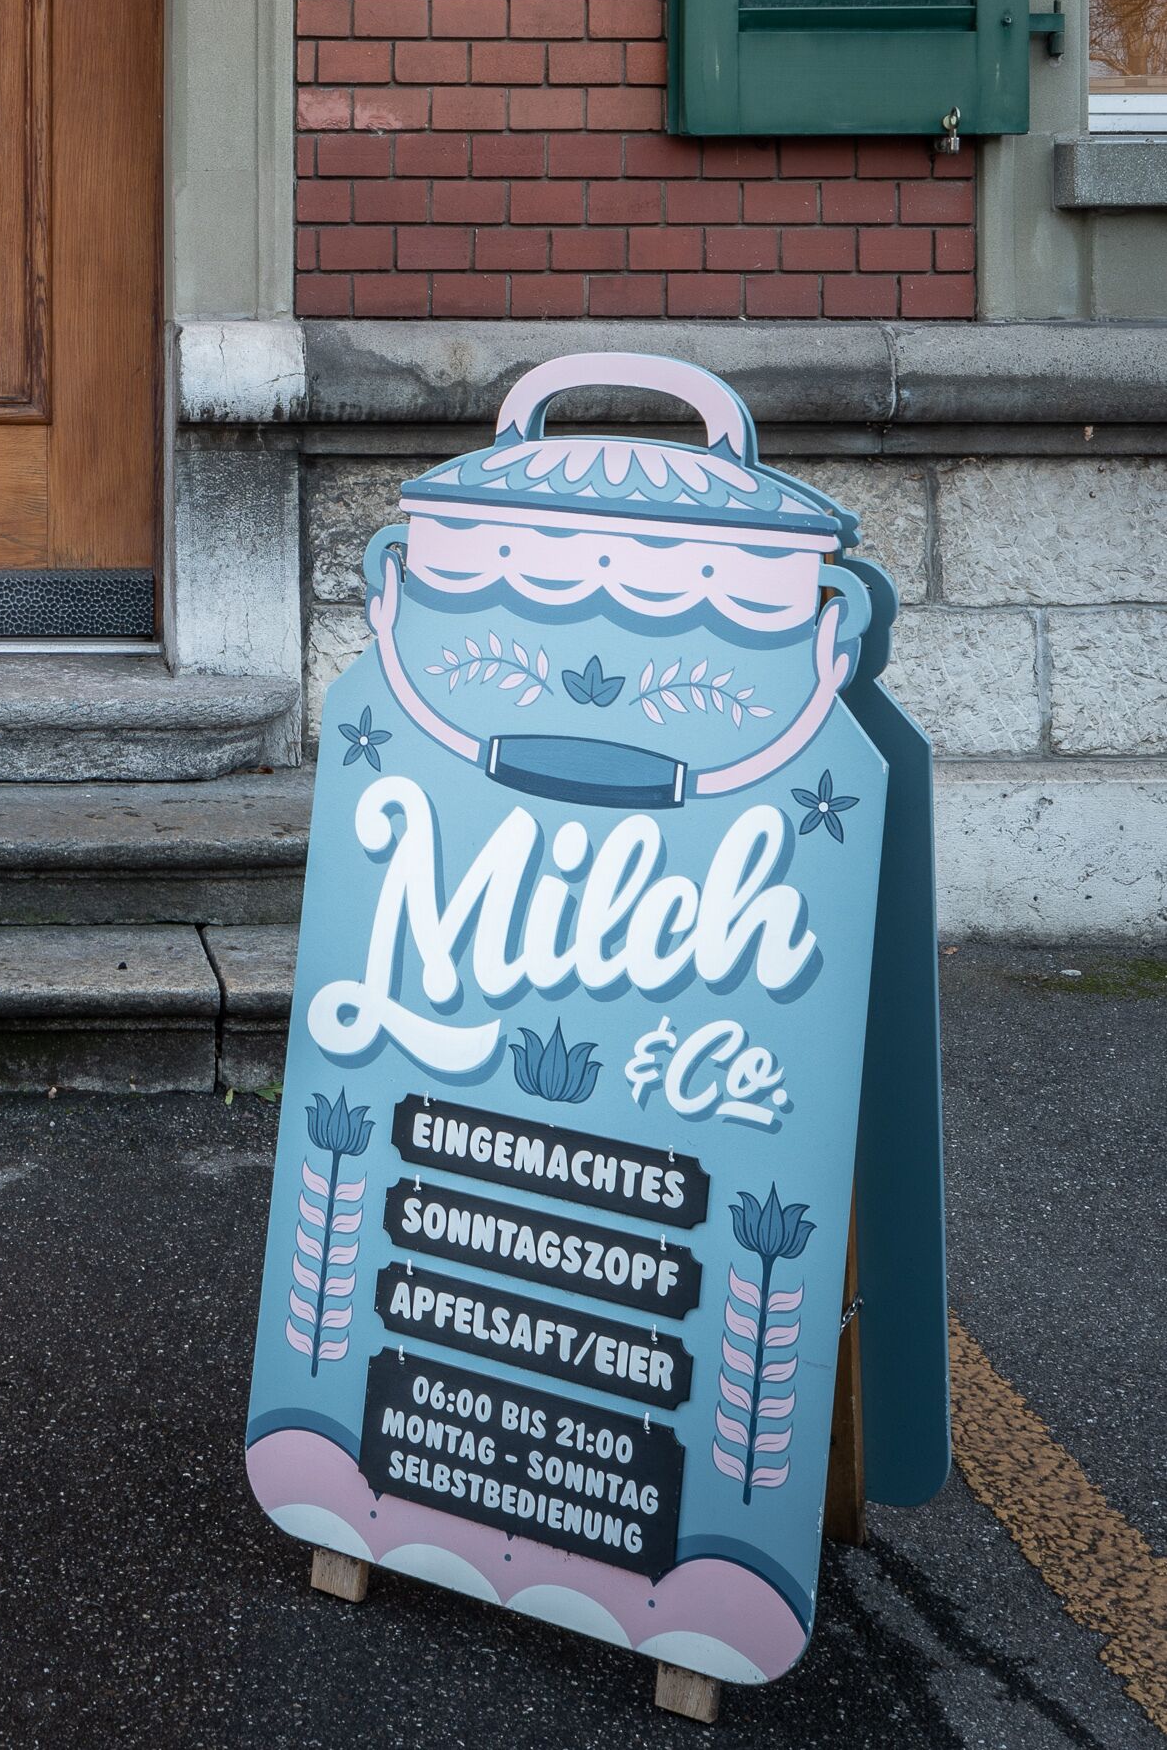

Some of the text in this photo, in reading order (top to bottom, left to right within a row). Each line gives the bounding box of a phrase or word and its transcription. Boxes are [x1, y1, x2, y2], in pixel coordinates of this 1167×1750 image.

[307, 775, 817, 1072] Milch
[412, 1112, 686, 1209] EINGEMACHTES
[401, 1197, 680, 1297] SONNTAGSZOPF
[389, 1282, 675, 1391] APFELSAFT/EIER
[381, 1408, 496, 1465] MONTAG
[527, 1450, 659, 1516] SONNTAG
[412, 1376, 634, 1464] 06:00 BIS 21:00
[388, 1450, 643, 1553] SELBSTBEDIENUNG
